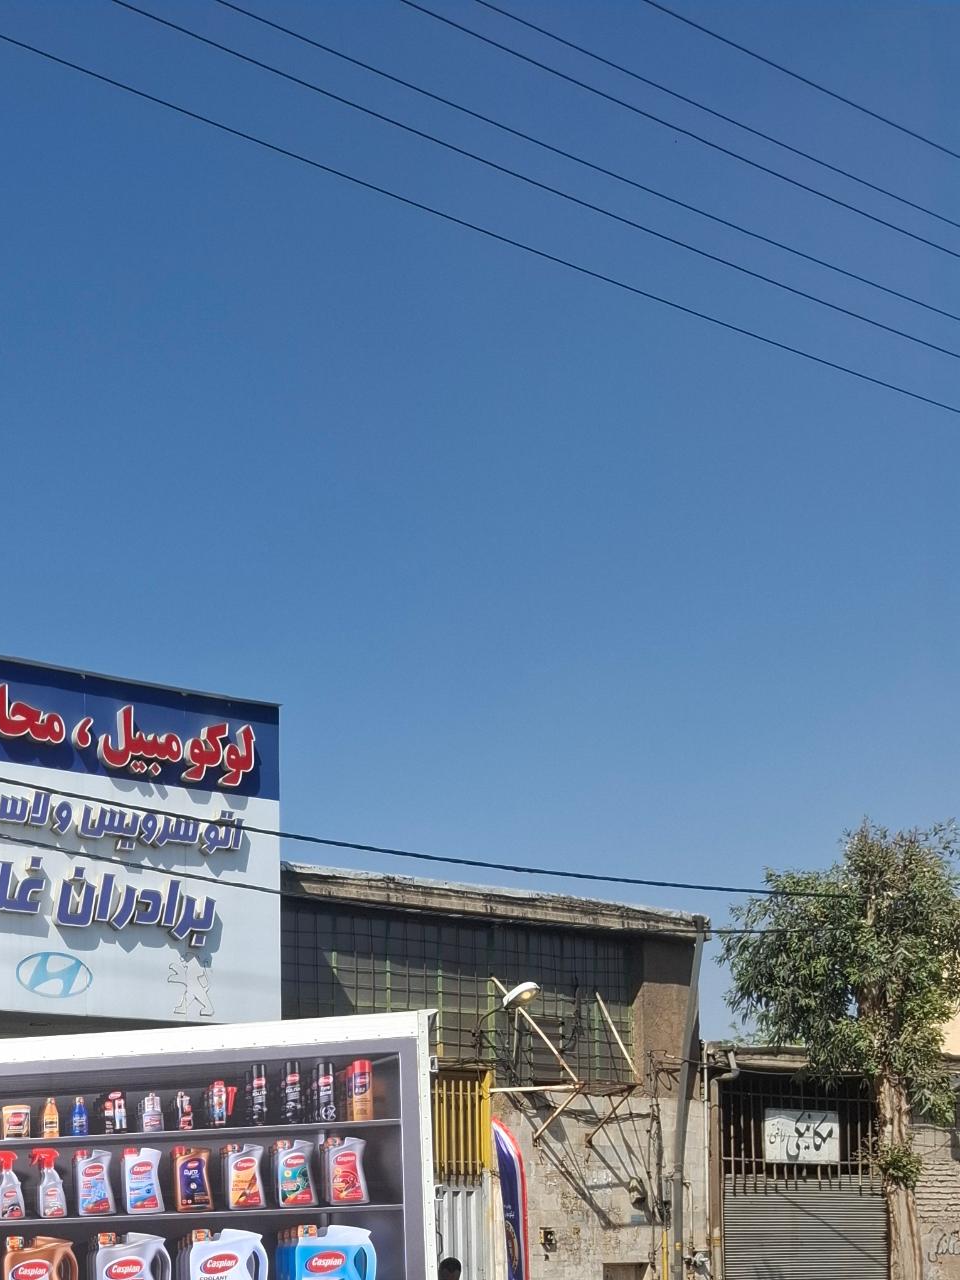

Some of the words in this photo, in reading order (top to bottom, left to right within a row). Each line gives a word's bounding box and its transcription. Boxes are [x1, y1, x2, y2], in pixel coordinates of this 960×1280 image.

[55, 866, 216, 947] برادران
[206, 1258, 235, 1269] Caspian
[312, 1257, 343, 1268] Caspian
[18, 1266, 47, 1276] Caspian
[111, 1264, 141, 1274] Caspian
